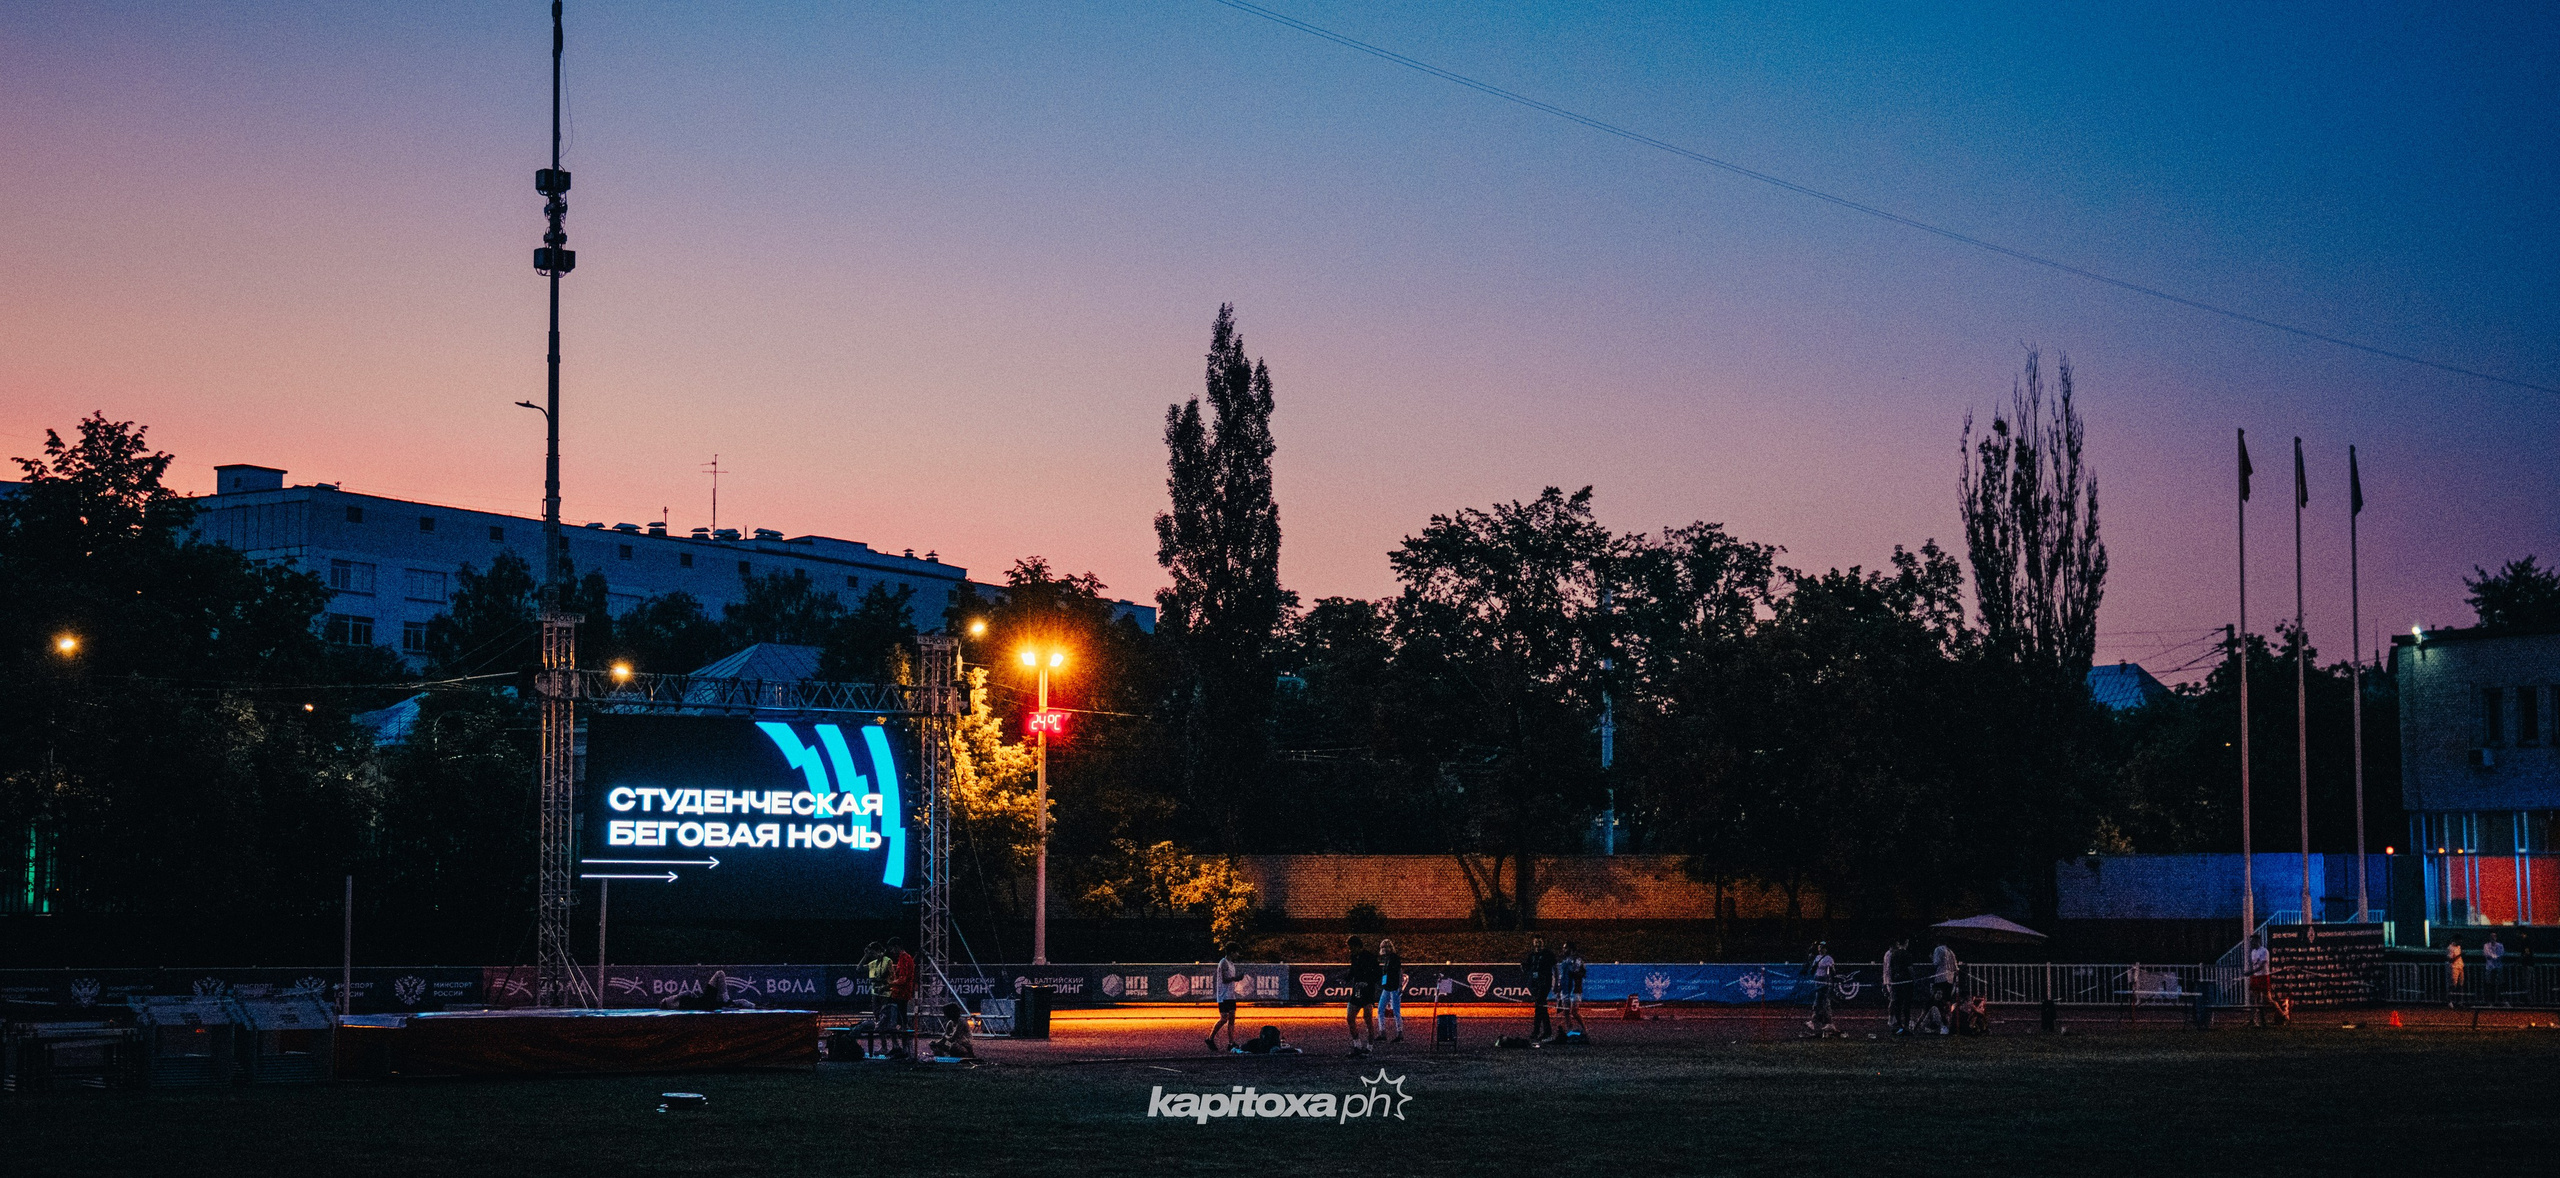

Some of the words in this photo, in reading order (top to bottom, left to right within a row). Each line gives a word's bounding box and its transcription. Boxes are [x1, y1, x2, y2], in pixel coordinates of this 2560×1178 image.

[608, 786, 883, 816] СТУДЕНЧЕСКАЯ
[608, 820, 779, 848] БЕГОВАЯ
[787, 824, 882, 849] НОЧЬ
[433, 981, 473, 989] МИНСПОРТ
[653, 979, 703, 994] ВФЛА
[766, 978, 816, 993] ВФЛА
[947, 976, 995, 984] АЛТИЙСКИЙ
[1033, 976, 1084, 984] БАЛТИЙСКИЙ
[1125, 975, 1148, 989] НГК
[1191, 975, 1213, 989] НГК
[1256, 975, 1280, 989] НГК
[1324, 987, 1354, 996] СЛЛ
[1493, 987, 1532, 996] СЛЛА
[1631, 998, 1640, 1012] 5
